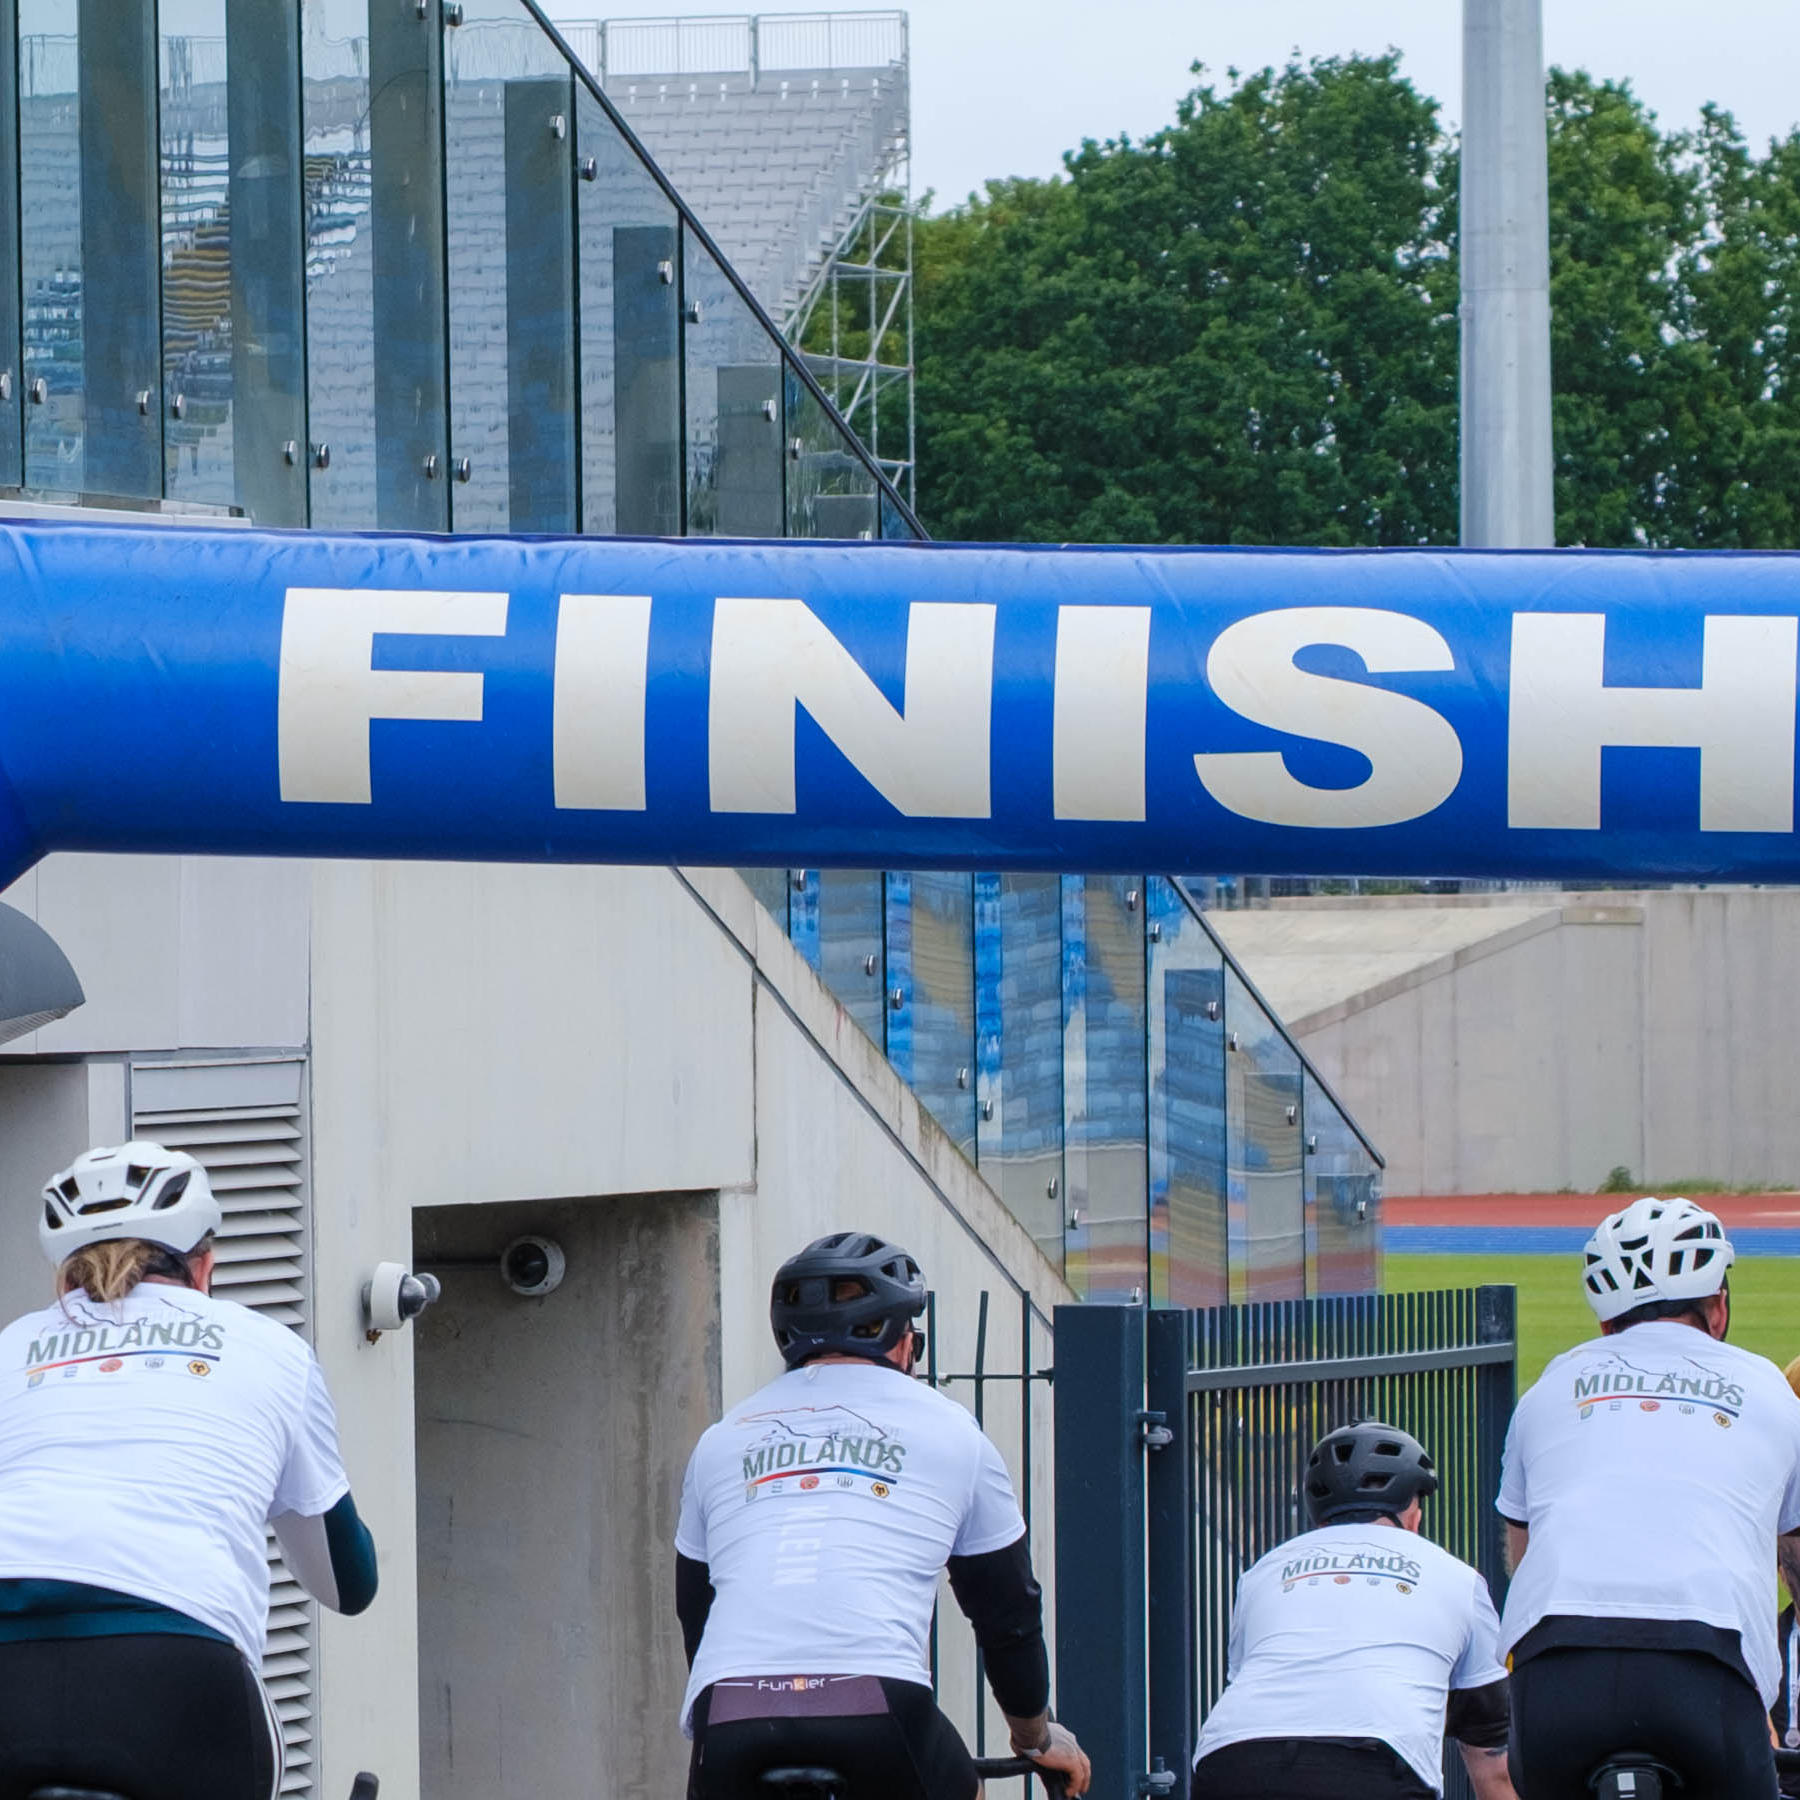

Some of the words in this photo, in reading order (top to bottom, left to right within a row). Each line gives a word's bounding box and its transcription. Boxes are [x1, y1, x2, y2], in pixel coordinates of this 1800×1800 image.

[278, 586, 1800, 833] FINISH
[26, 1322, 225, 1366] MIDLANDS
[1574, 1374, 1745, 1407] MIDLANDS
[743, 1437, 906, 1481] MIDLANDS
[1281, 1556, 1422, 1581] MIDLANDS
